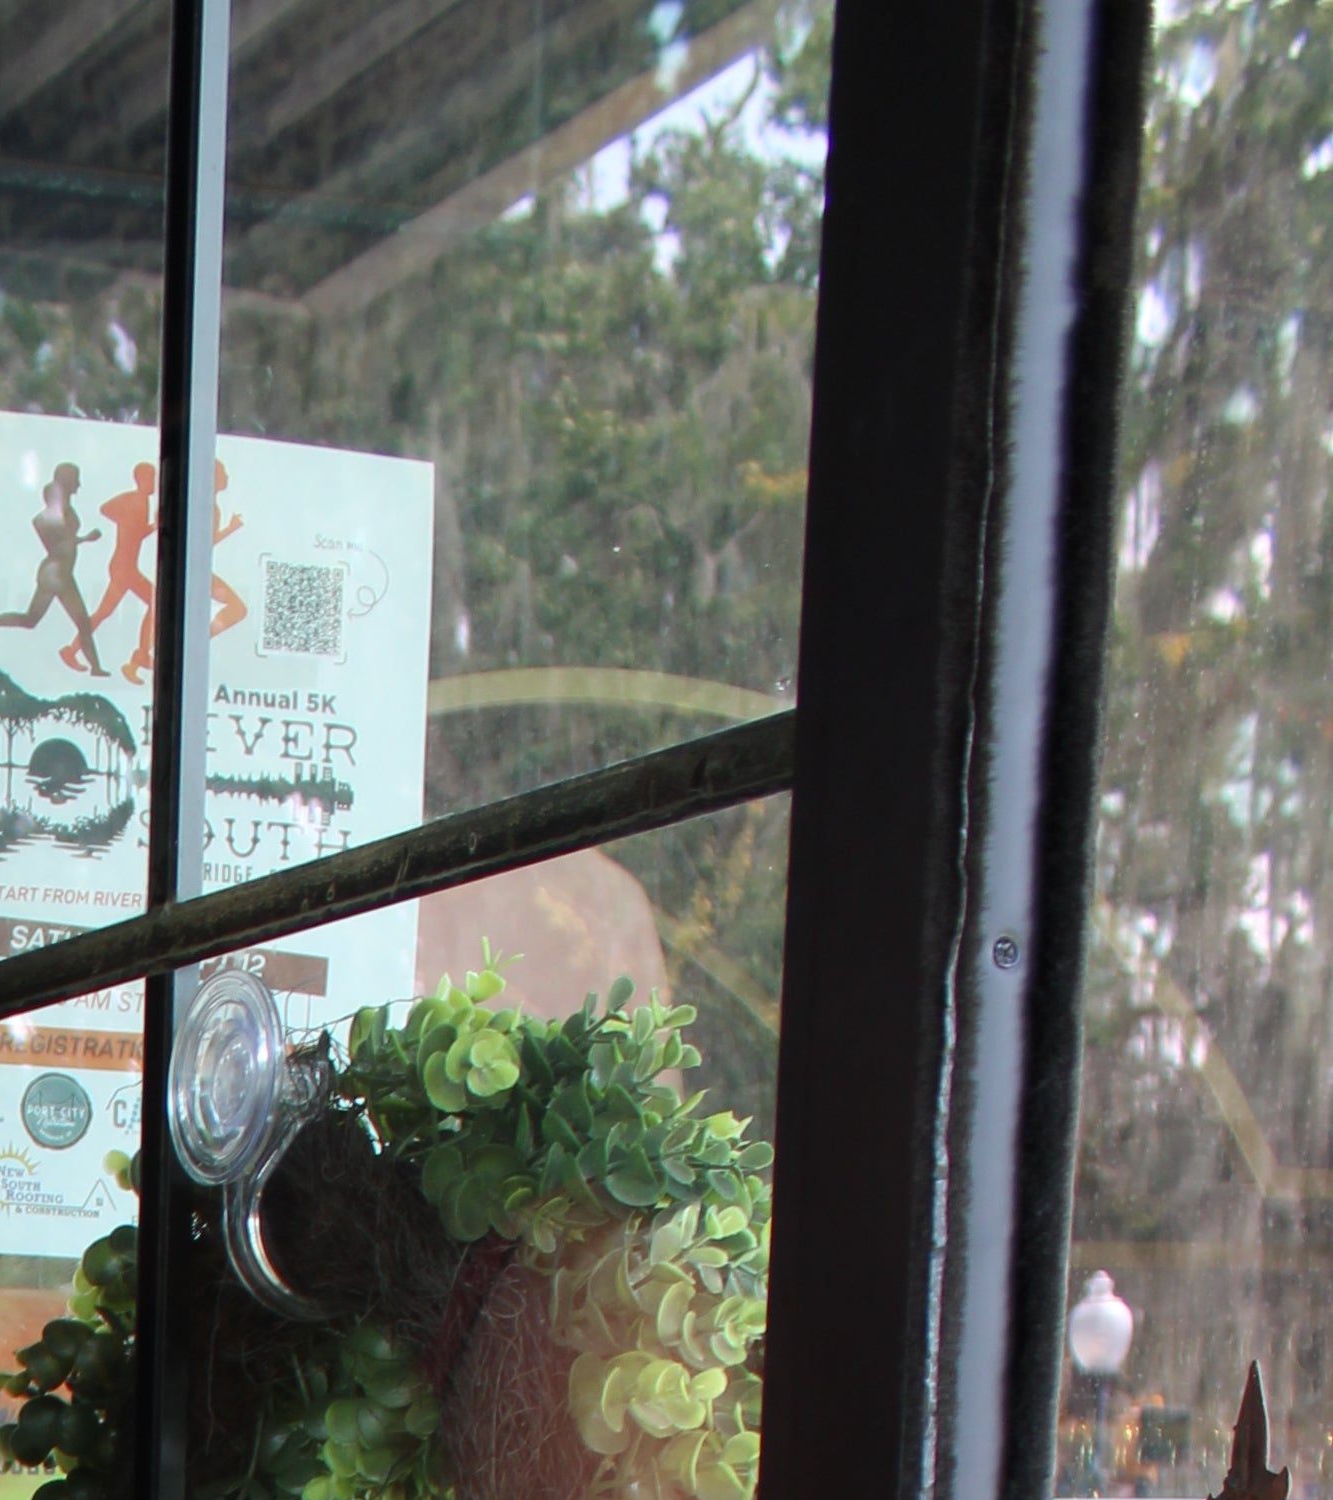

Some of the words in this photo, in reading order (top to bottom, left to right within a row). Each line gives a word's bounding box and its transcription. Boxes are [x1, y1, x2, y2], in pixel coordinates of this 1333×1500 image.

[213, 684, 298, 710] Annual
[306, 693, 338, 714] 5K
[42, 888, 90, 905] FROM
[93, 891, 143, 908] RIVER
